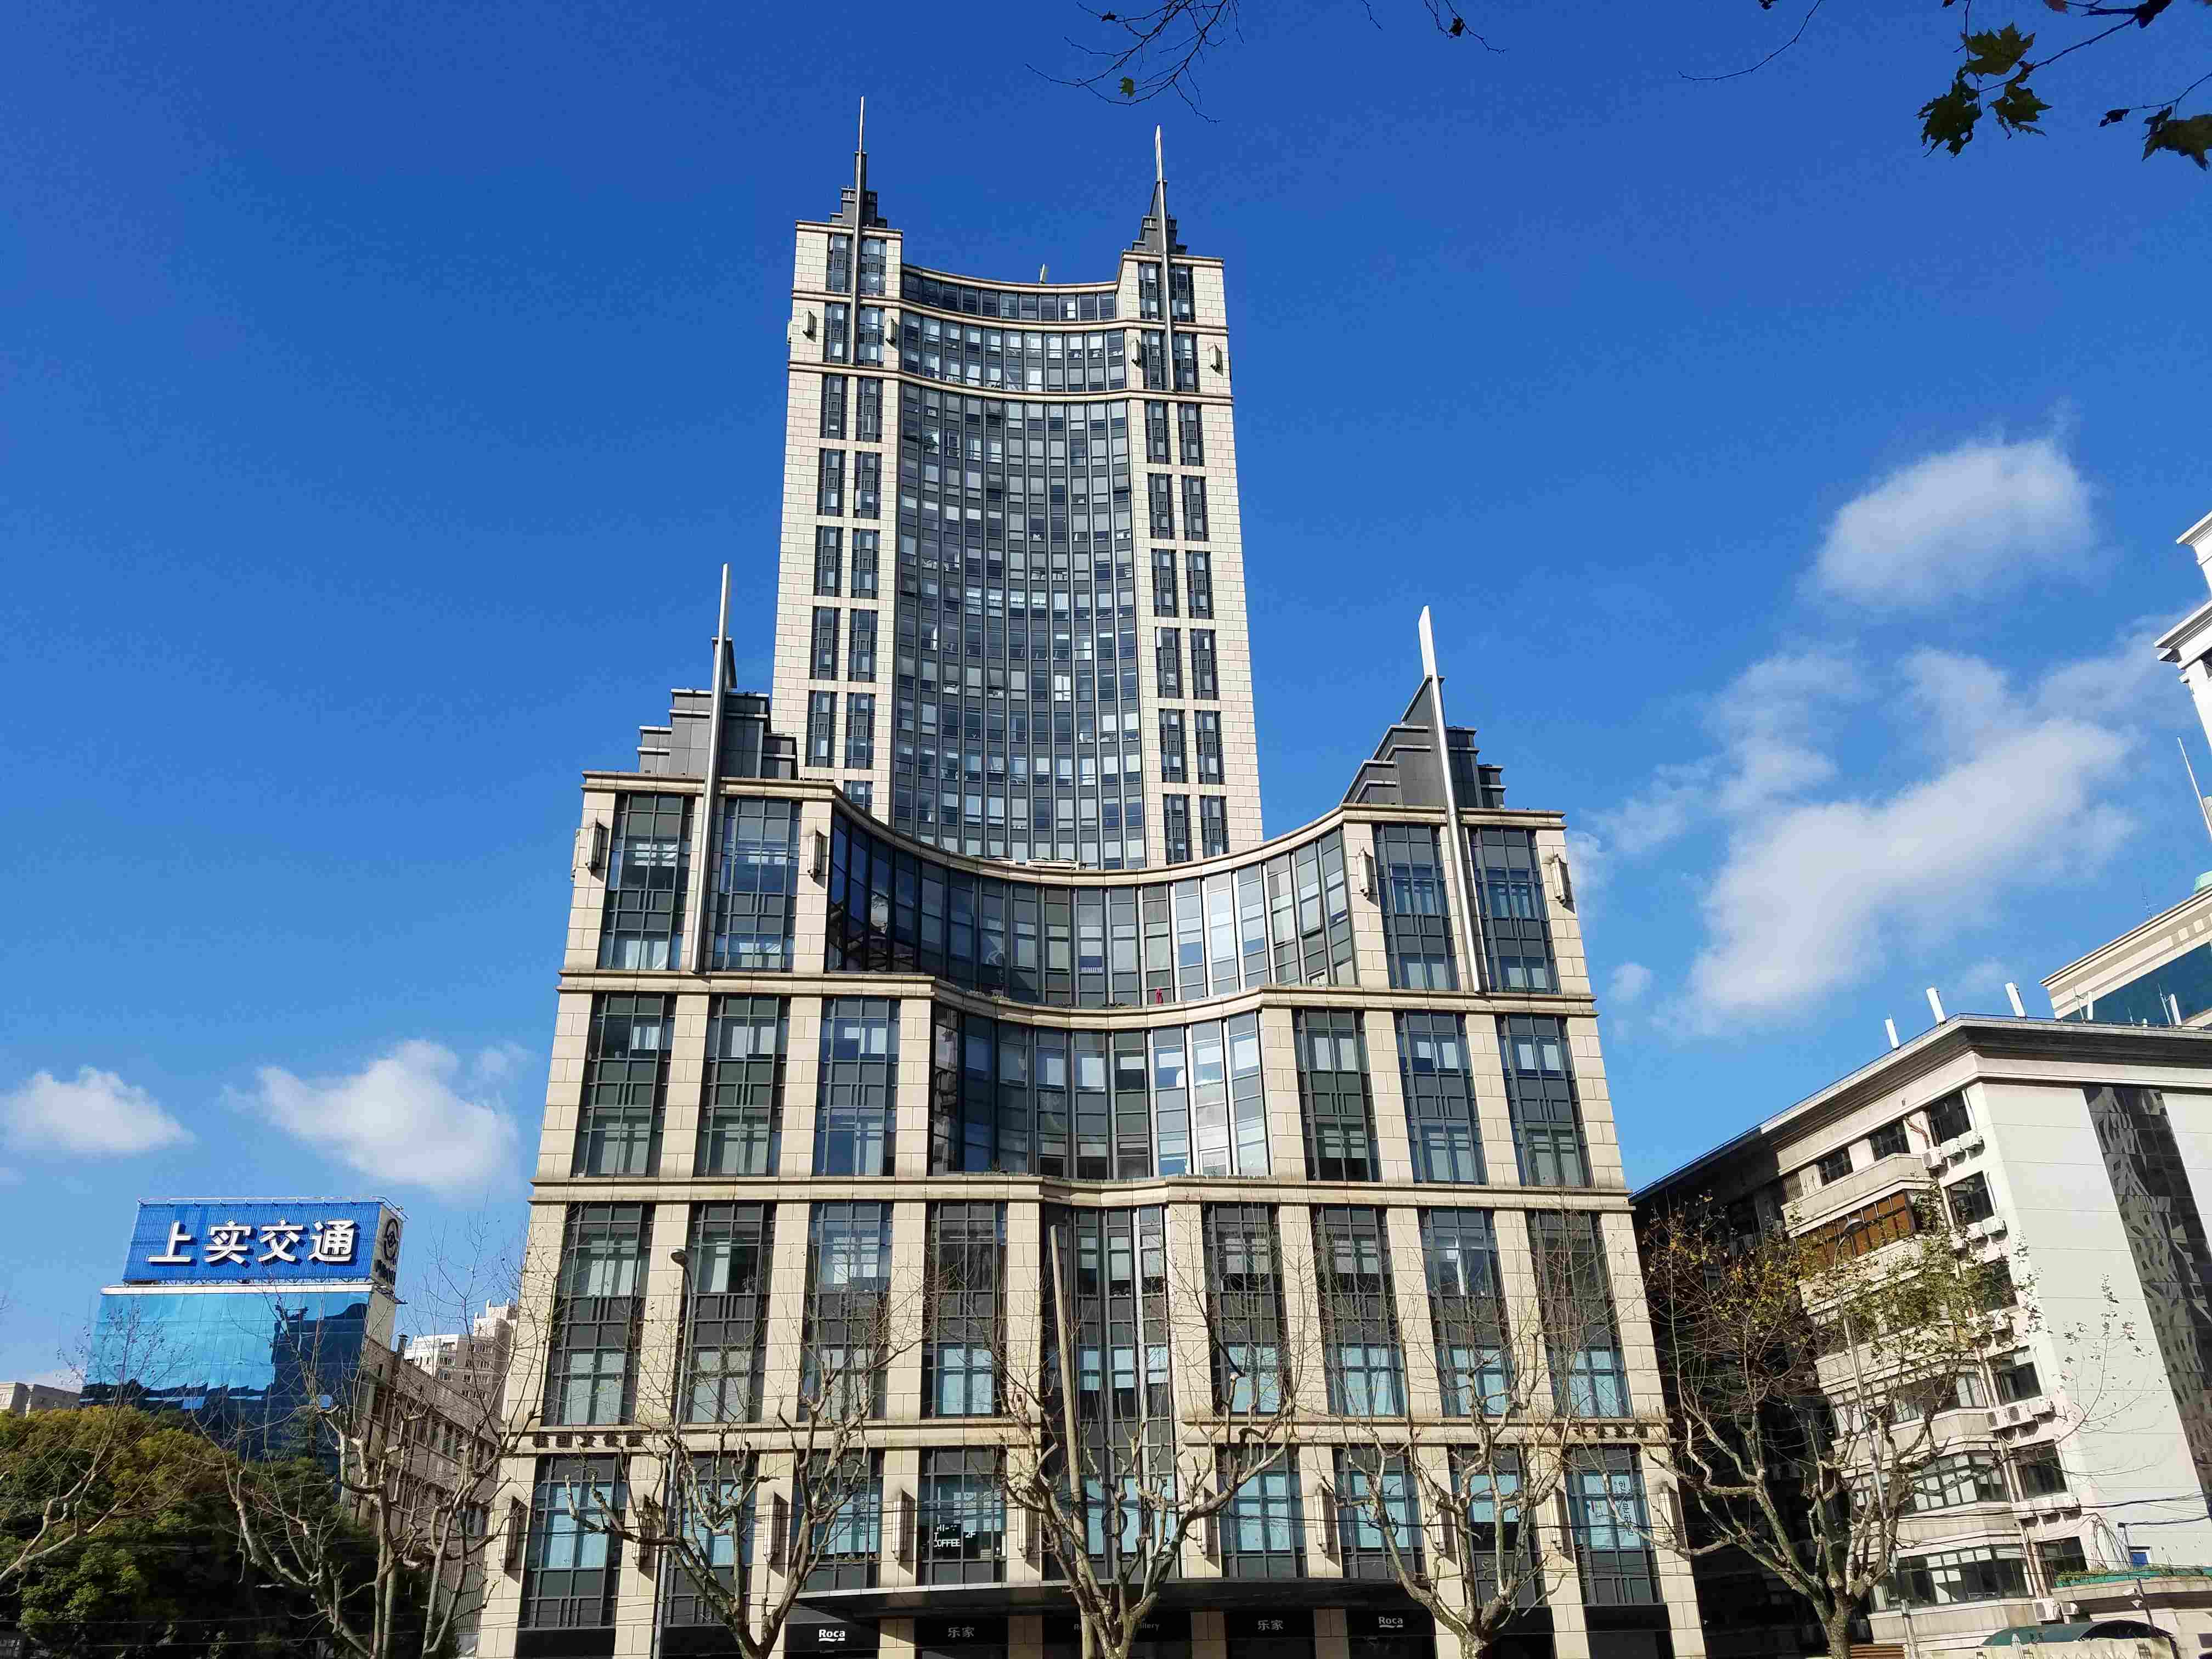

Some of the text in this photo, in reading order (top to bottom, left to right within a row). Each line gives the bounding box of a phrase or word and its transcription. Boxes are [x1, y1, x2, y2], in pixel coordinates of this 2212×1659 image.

[147, 1218, 355, 1264] 上实交通
[933, 1539, 961, 1548] COFFEE
[1257, 1619, 1284, 1631] 乐家
[1378, 1616, 1403, 1624] Roca
[819, 1629, 846, 1638] Roca
[947, 1627, 975, 1638] 乐家
